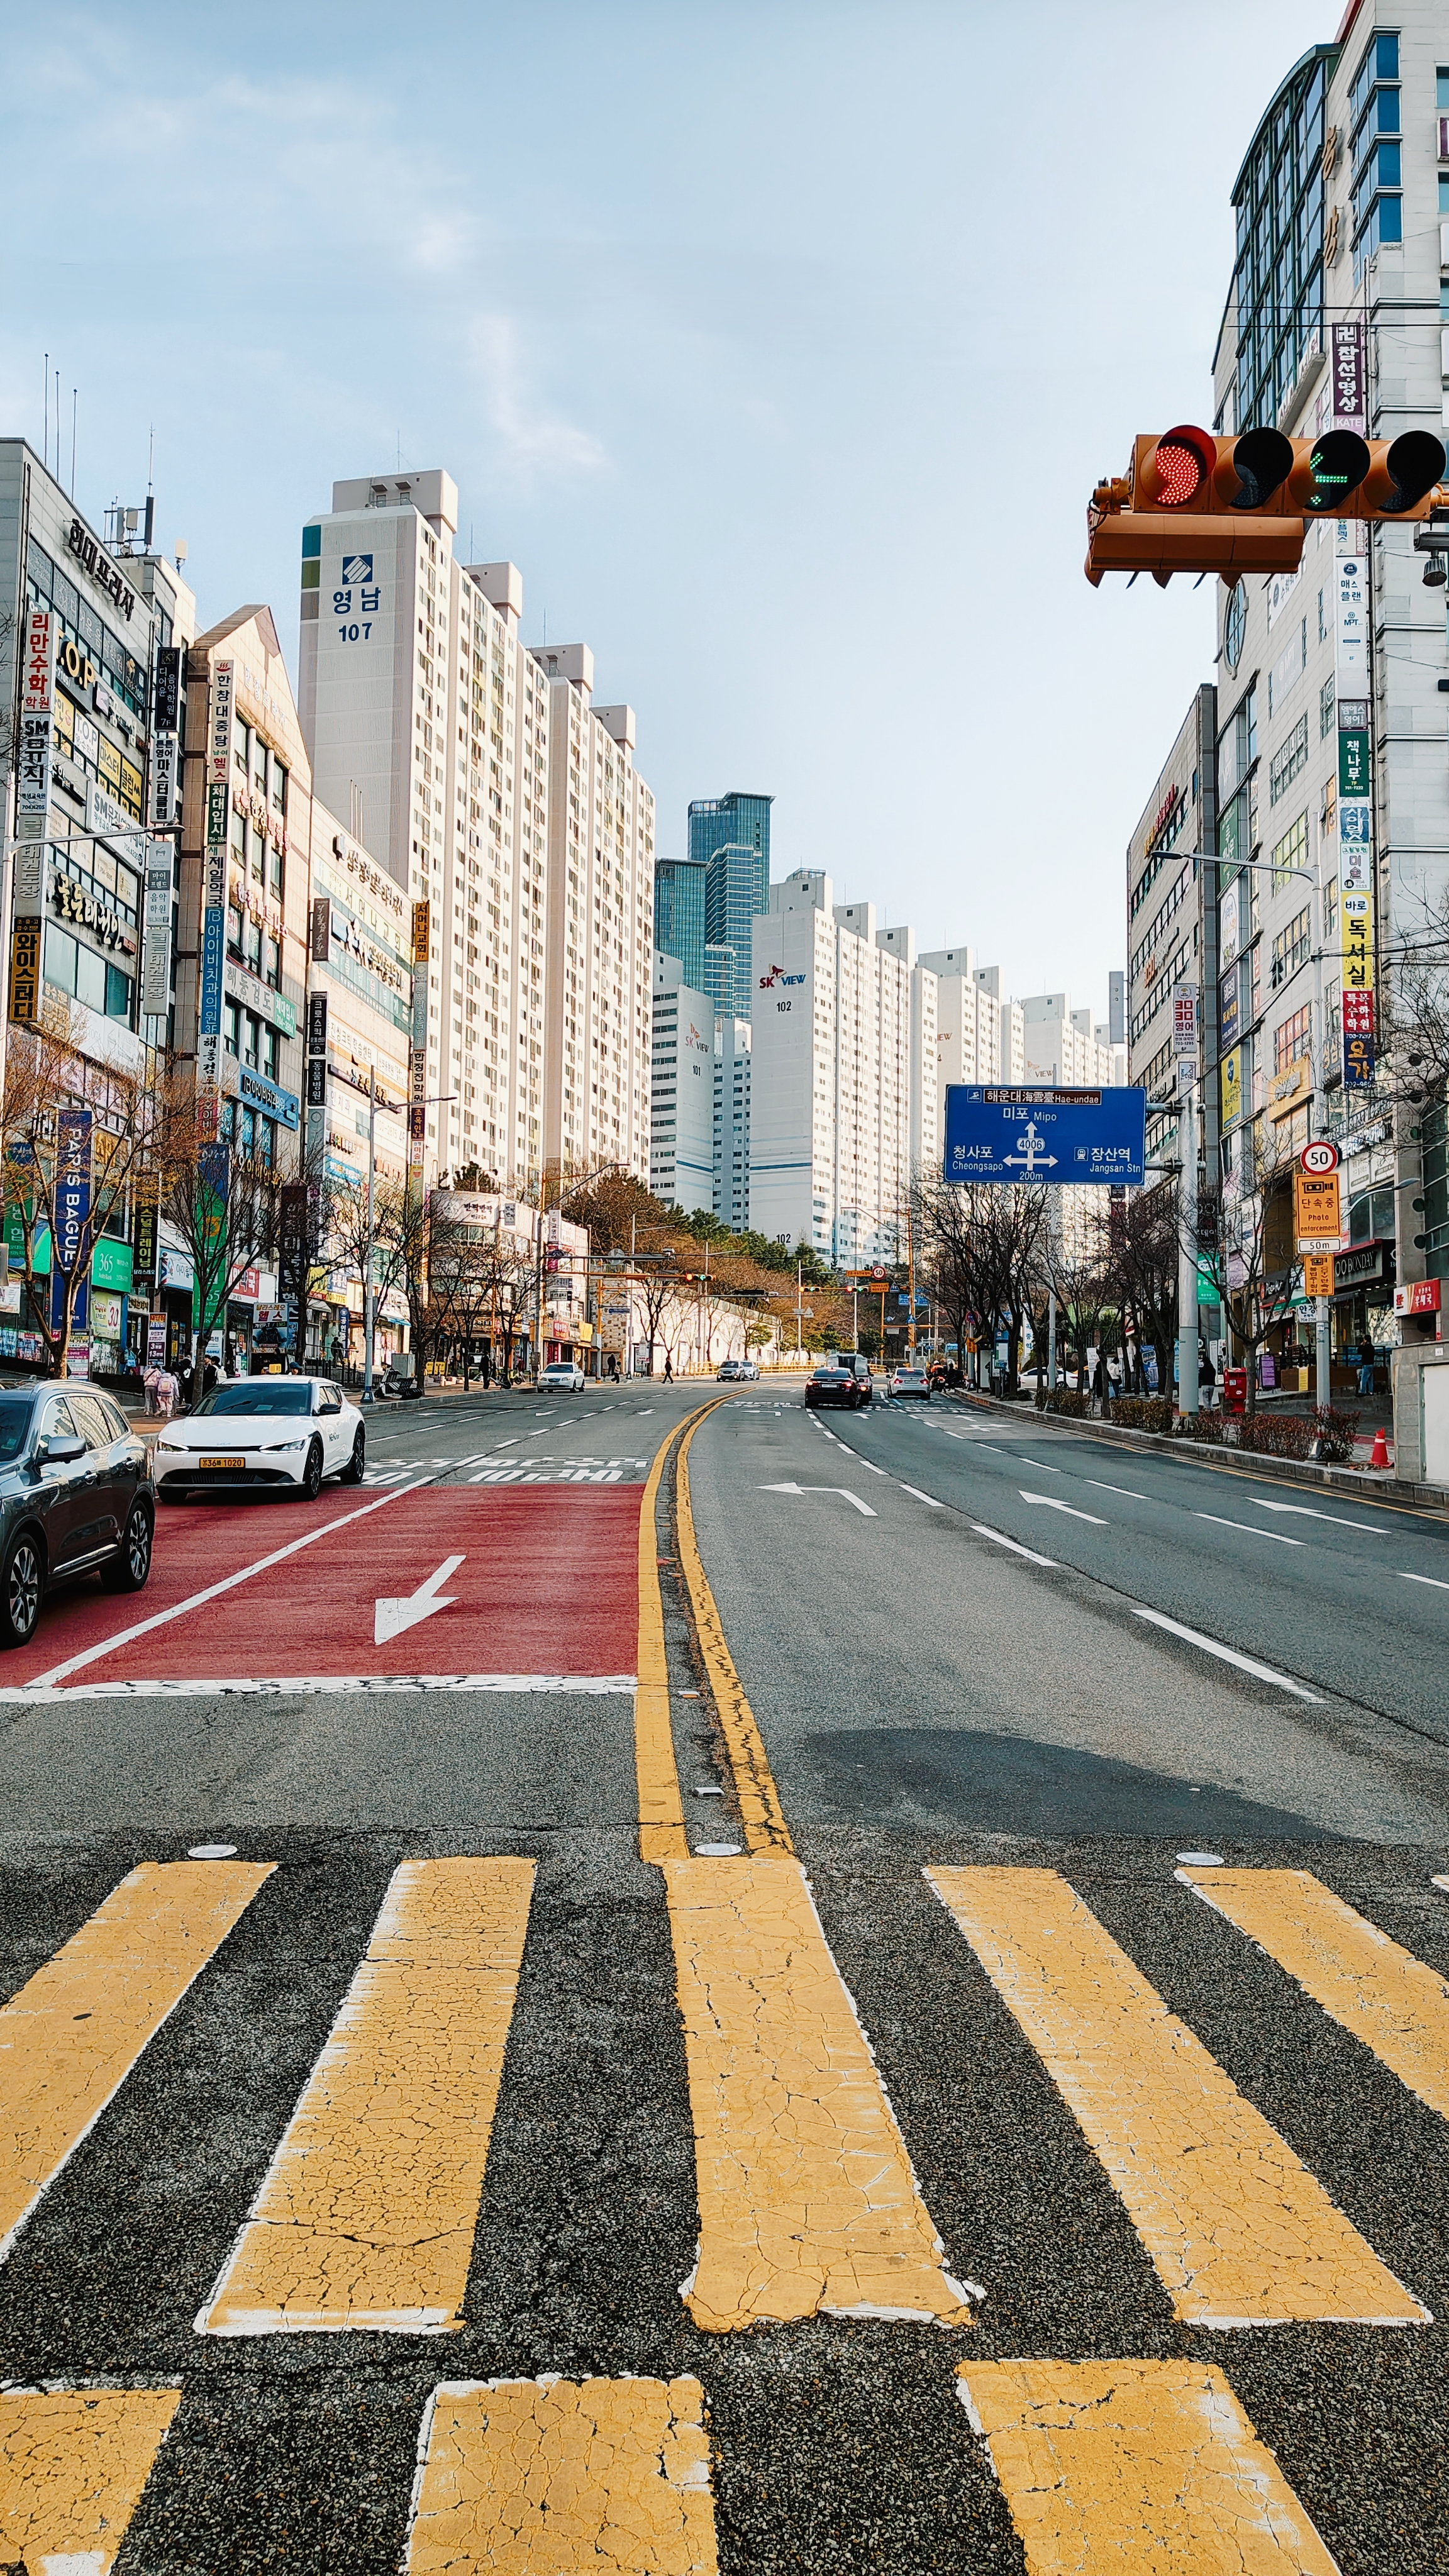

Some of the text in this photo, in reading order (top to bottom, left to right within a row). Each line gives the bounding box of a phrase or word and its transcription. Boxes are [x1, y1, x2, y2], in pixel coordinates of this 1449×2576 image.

[333, 587, 381, 614] 영남
[339, 623, 372, 641] 107
[28, 614, 50, 695] 리만수학
[25, 696, 50, 709] 학원
[214, 675, 231, 747] 한창대중탕
[1344, 715, 1360, 724] 영어
[155, 748, 173, 758] 영어
[1346, 740, 1361, 780] 책나무
[213, 757, 226, 782] 헬스
[155, 759, 170, 820] 마스터클럽
[211, 785, 225, 836] 체대입시
[1349, 855, 1362, 879] 미술
[150, 893, 167, 902] 음악
[150, 904, 166, 914] 학원
[1345, 901, 1367, 911] 바로
[416, 904, 428, 953] 서머나교회
[1348, 919, 1368, 985] 독서실
[13, 934, 38, 1019] 와이스터디
[204, 924, 221, 1024] 아이비치과의원
[760, 974, 806, 989] SK VIEW
[777, 1001, 792, 1012] 102
[204, 1025, 218, 1034] 3F
[1175, 1022, 1194, 1031] 영어
[686, 1036, 709, 1053] SK VIEW
[692, 1065, 701, 1077] 101
[312, 1062, 323, 1101] 동물병원
[987, 1090, 1021, 1103] 해운대
[1055, 1094, 1099, 1104] Hae-undae
[1002, 1106, 1057, 1123] 미포 Mipo
[1019, 1140, 1043, 1150] 4006
[953, 1145, 994, 1160] 청사포
[1091, 1148, 1131, 1162] 장산역
[1311, 1152, 1328, 1165] 50
[952, 1161, 1003, 1172] Cheongsapo
[1090, 1163, 1141, 1175] Jangsan Stn
[1019, 1171, 1043, 1180] 200m
[1302, 1197, 1335, 1209] 단속중
[1301, 1224, 1338, 1233] enforcement
[776, 1233, 791, 1243] 102
[1309, 1241, 1330, 1250] 50m
[99, 1252, 114, 1274] 365
[466, 1469, 624, 1482] 어린이
